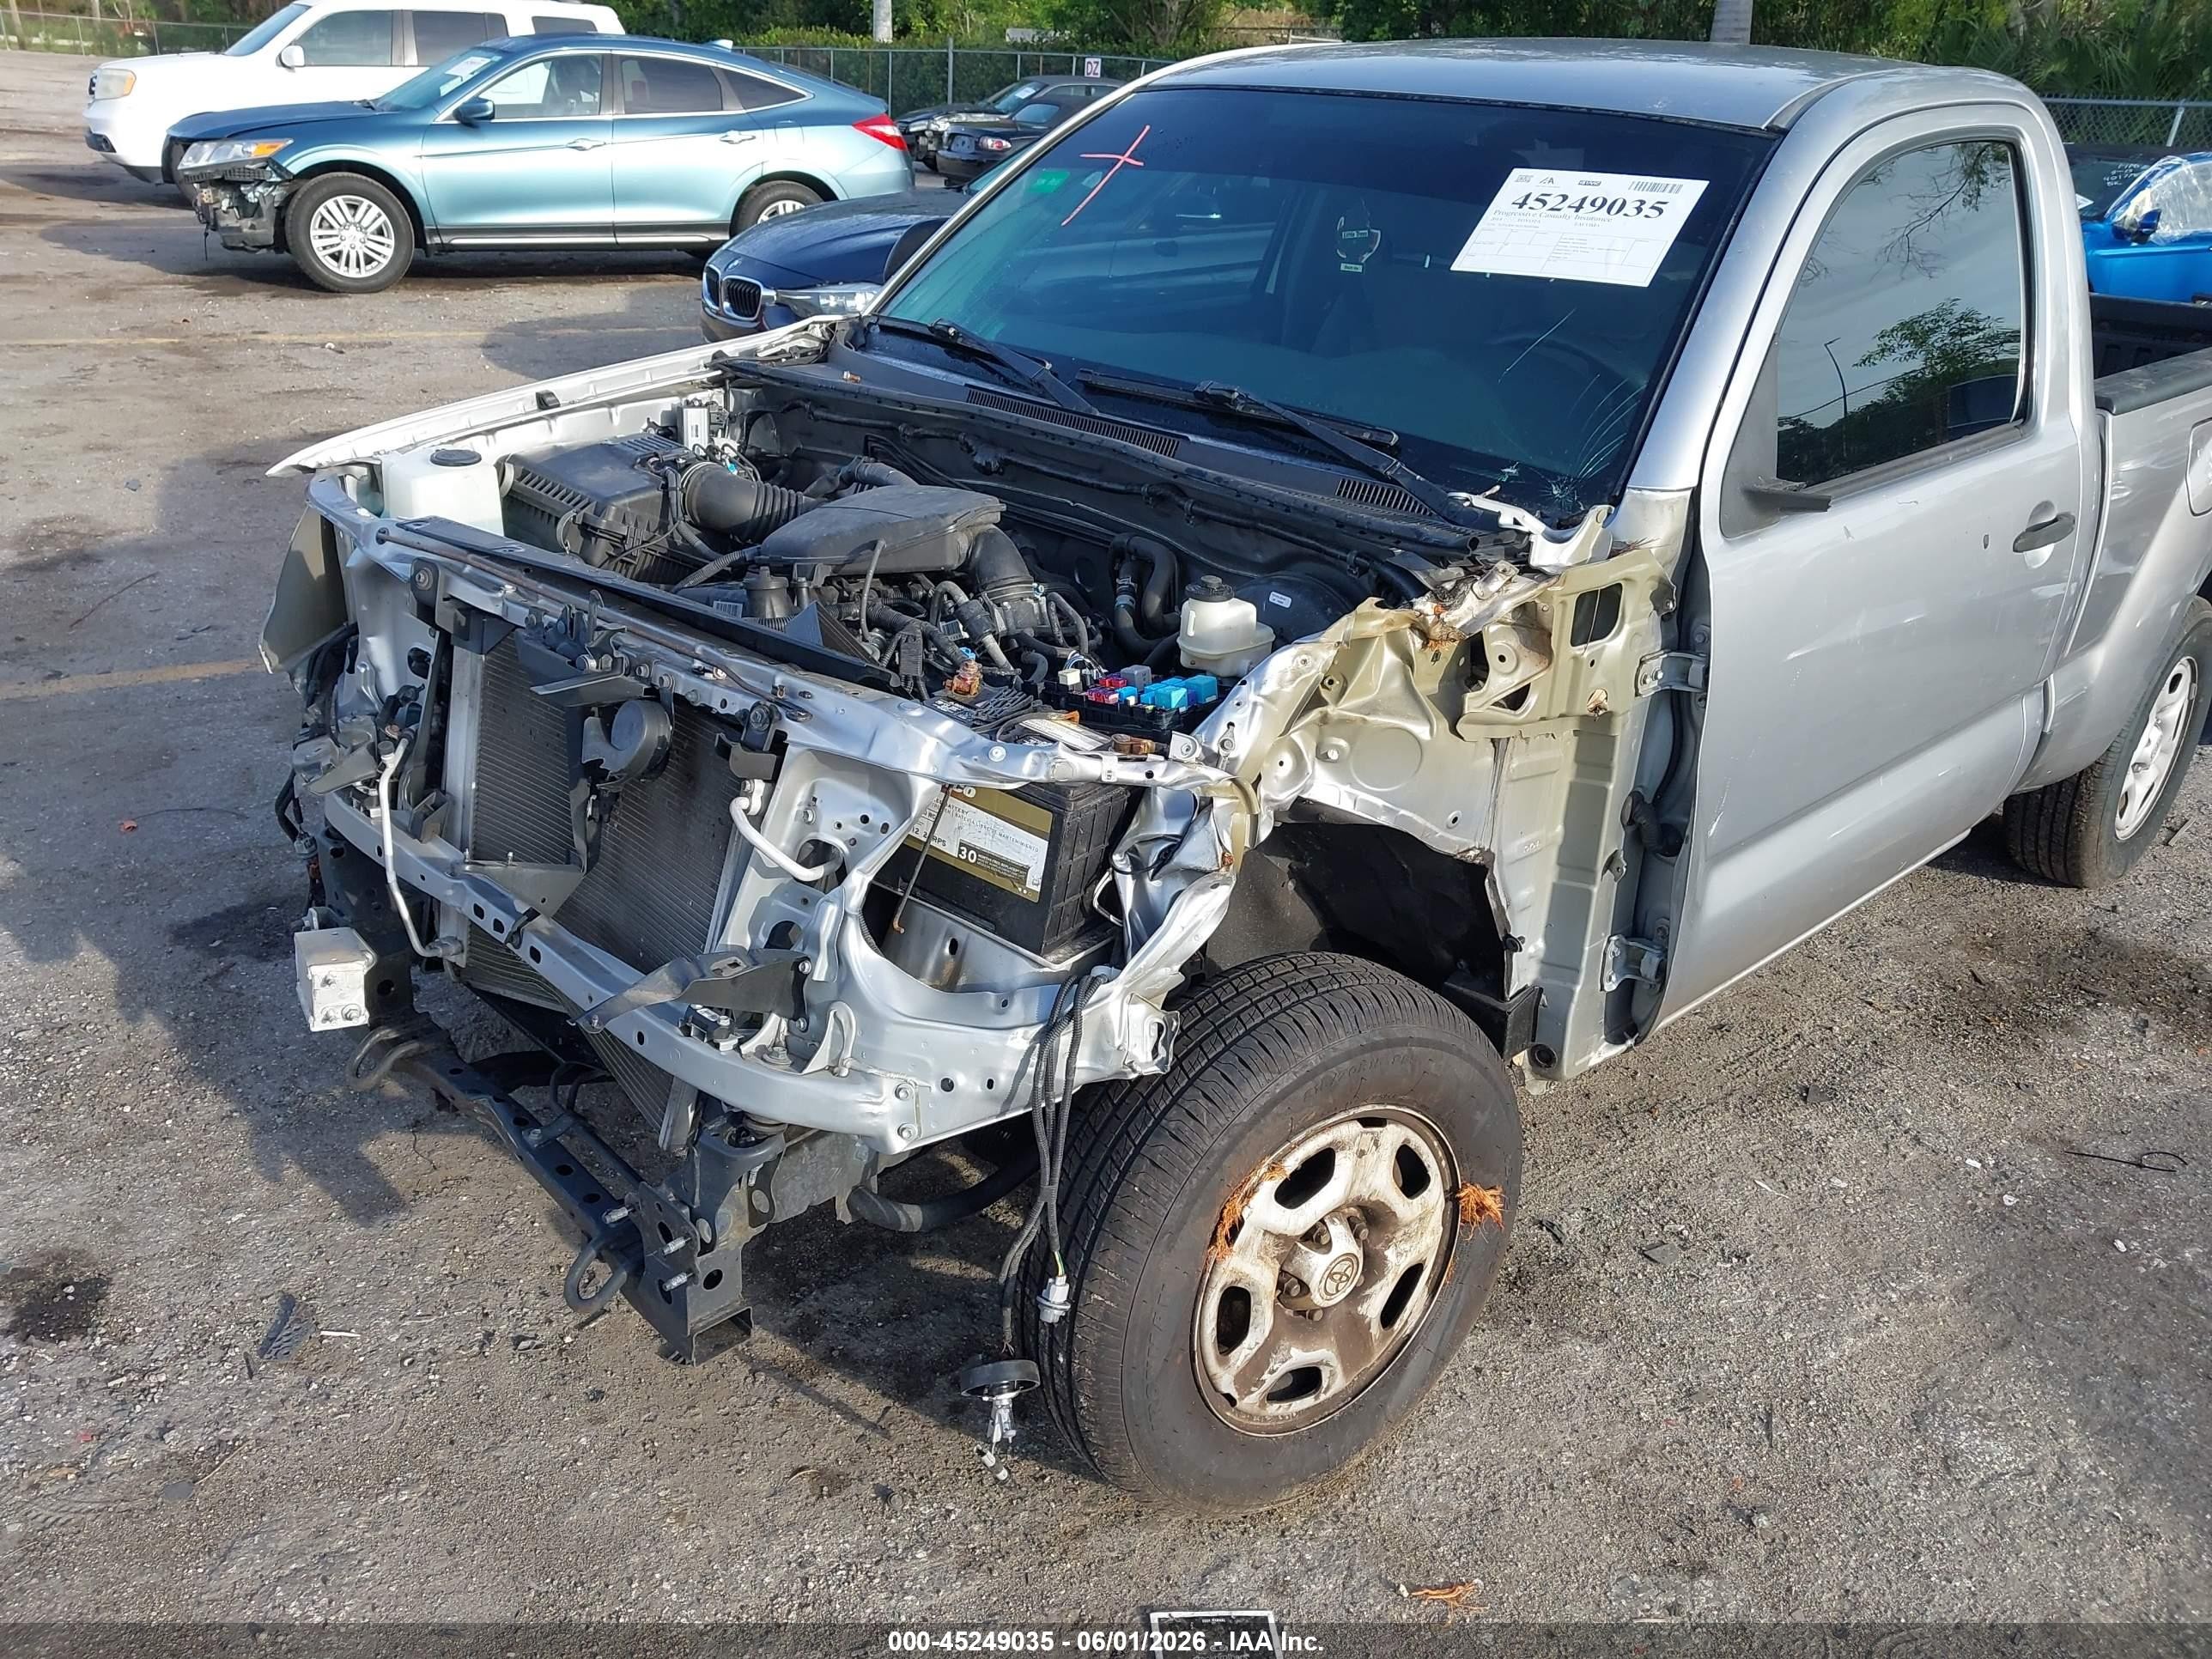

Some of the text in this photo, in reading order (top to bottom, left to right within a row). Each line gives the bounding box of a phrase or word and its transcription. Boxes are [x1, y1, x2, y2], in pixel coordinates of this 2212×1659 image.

[1086, 61, 1099, 76] DZ
[1511, 192, 1669, 218] 45249035
[958, 846, 977, 864] 30
